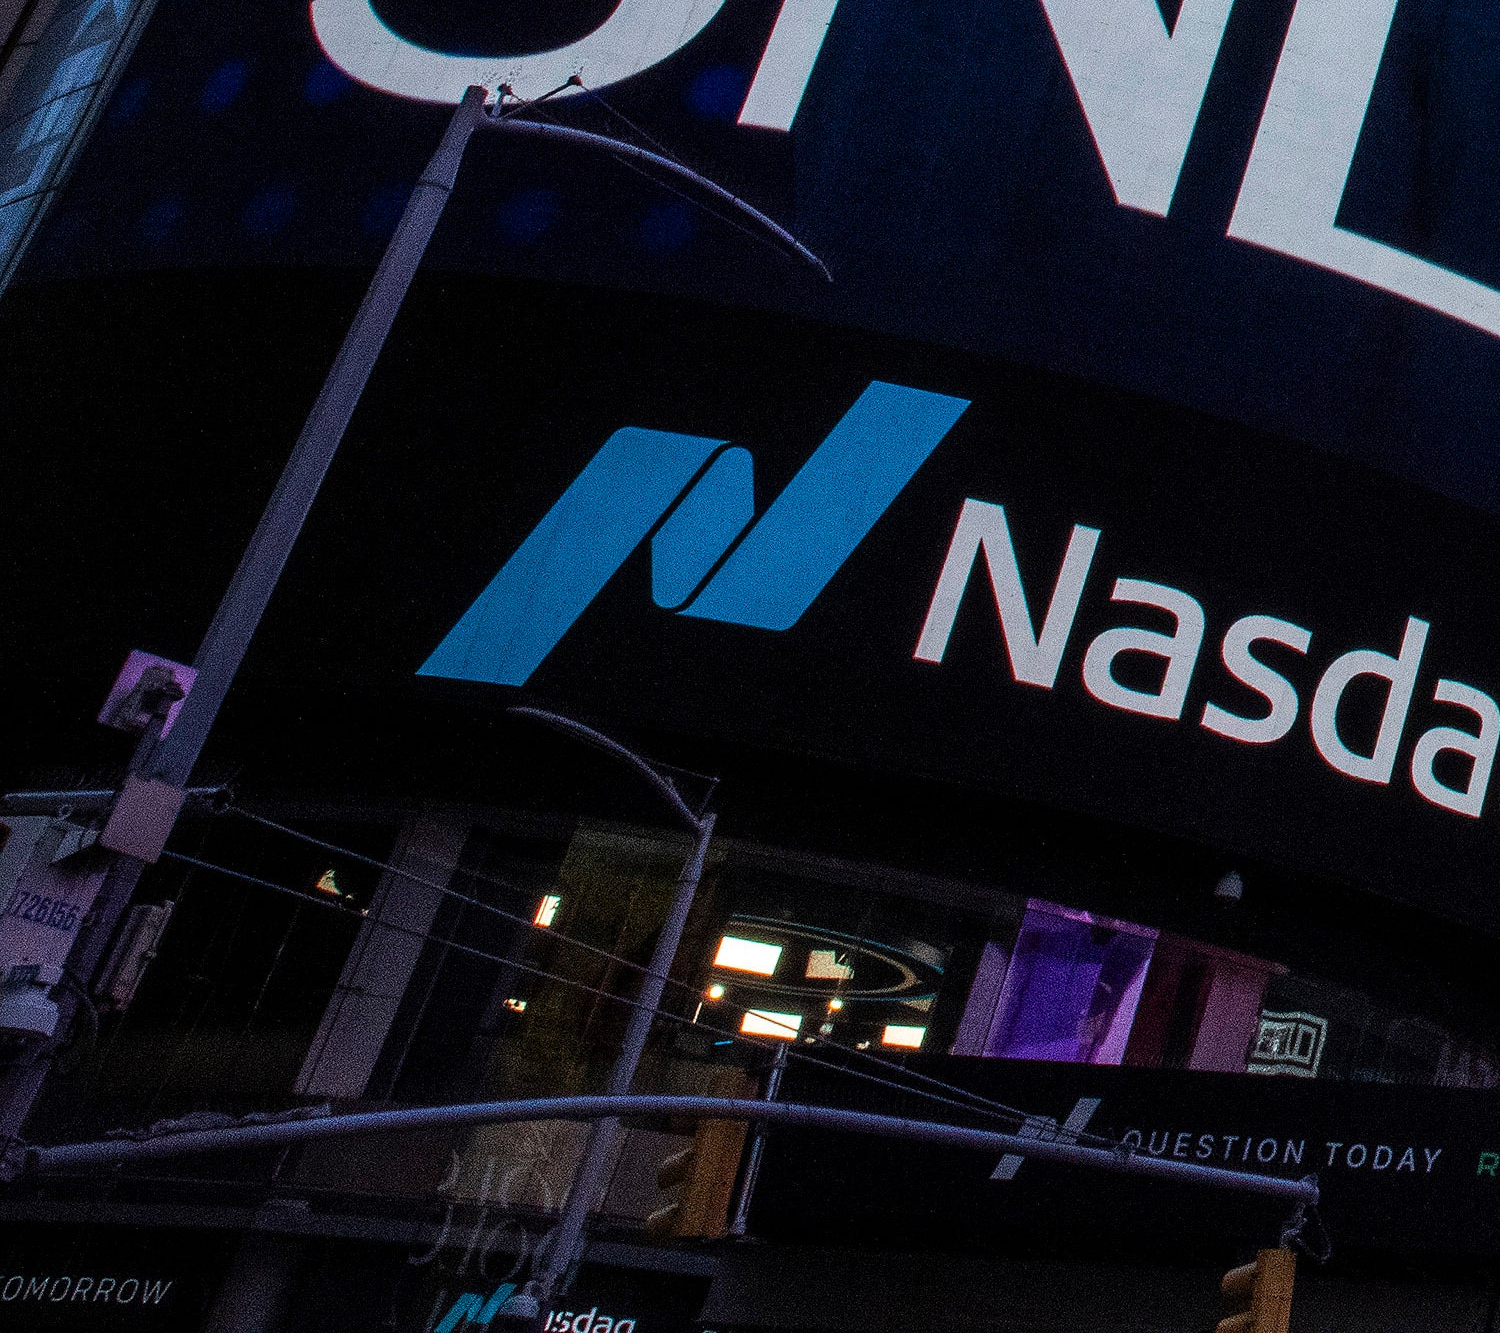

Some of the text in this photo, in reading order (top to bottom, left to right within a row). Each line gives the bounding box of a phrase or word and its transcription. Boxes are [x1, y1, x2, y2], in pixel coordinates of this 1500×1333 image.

[1119, 1128, 1307, 1166] QUESTION
[1324, 1140, 1443, 1174] TODAY
[0, 1273, 174, 1307] OMORROW
